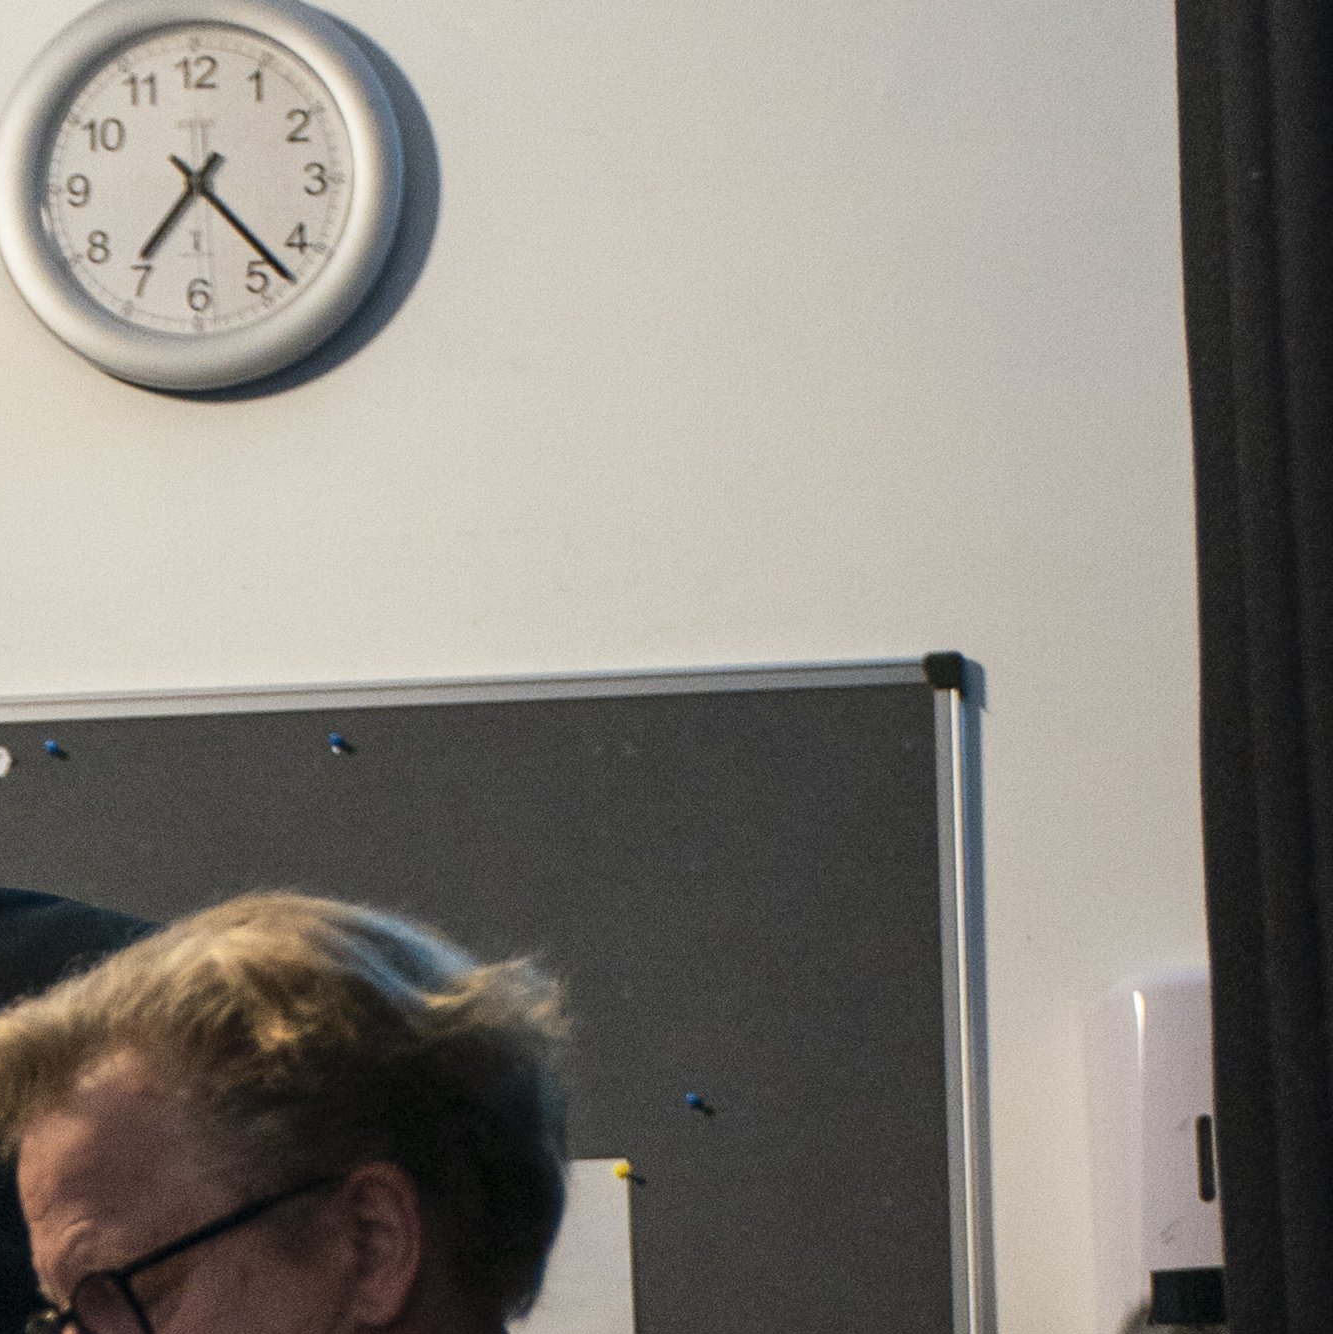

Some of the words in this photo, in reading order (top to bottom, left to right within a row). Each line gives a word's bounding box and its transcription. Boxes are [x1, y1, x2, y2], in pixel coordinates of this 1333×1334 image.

[122, 73, 157, 105] 11
[175, 56, 218, 89] 12
[248, 69, 263, 103] 1
[84, 117, 126, 152] 10
[286, 108, 310, 143] 2
[66, 173, 90, 208] 9
[303, 162, 327, 196] 3
[87, 230, 110, 265] 8
[284, 222, 308, 254] 4
[131, 263, 153, 298] 7
[246, 260, 269, 293] 5
[186, 278, 212, 312] 6
